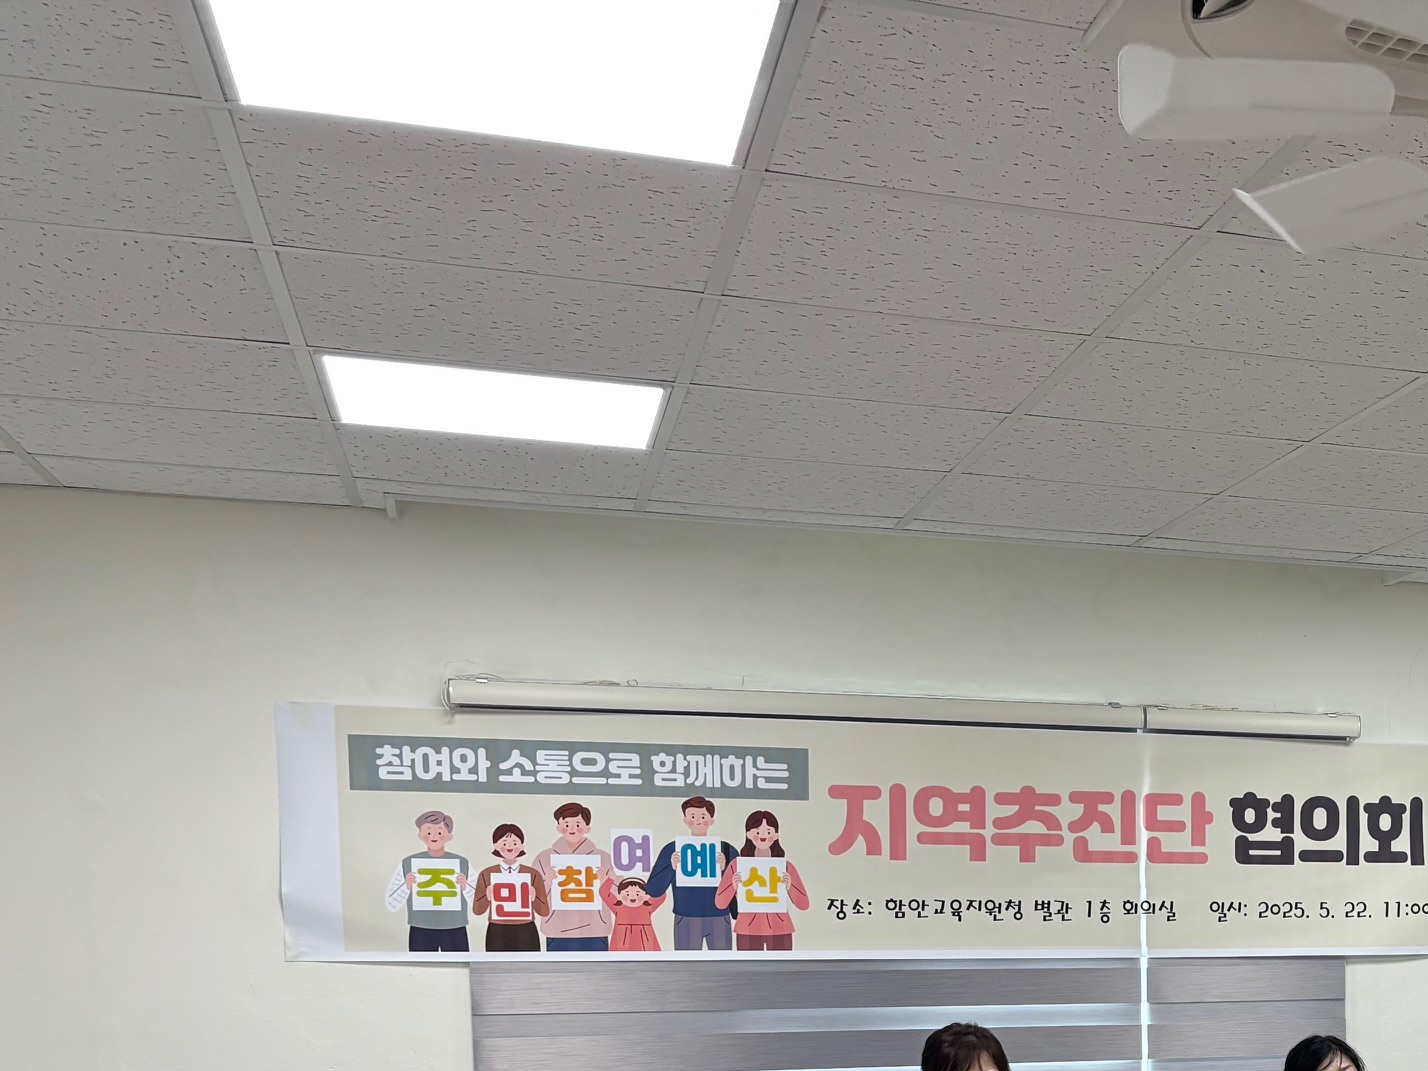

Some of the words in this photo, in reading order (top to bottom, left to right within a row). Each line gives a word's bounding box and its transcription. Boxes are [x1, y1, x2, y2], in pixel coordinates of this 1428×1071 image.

[375, 744, 490, 784] 참여와
[499, 749, 641, 786] 소통으로
[651, 751, 790, 791] 함께하는
[827, 783, 1214, 865] 지역추진단
[1229, 791, 1425, 867] 협의회
[416, 867, 458, 907] 주
[493, 881, 531, 918] 민
[557, 866, 598, 904] 참
[612, 834, 651, 873] 여
[680, 842, 717, 879] 예
[742, 866, 781, 902] 산
[826, 898, 873, 920] 장소:
[884, 898, 1024, 922] 함안교육지원청
[1034, 900, 1073, 922] 별관
[1085, 899, 1111, 924] 1층
[1122, 899, 1177, 922] 회의실
[1209, 901, 1248, 923] 일시:
[1257, 901, 1310, 919] 2025.
[1318, 901, 1335, 919] 5.
[1344, 901, 1372, 919] 22.
